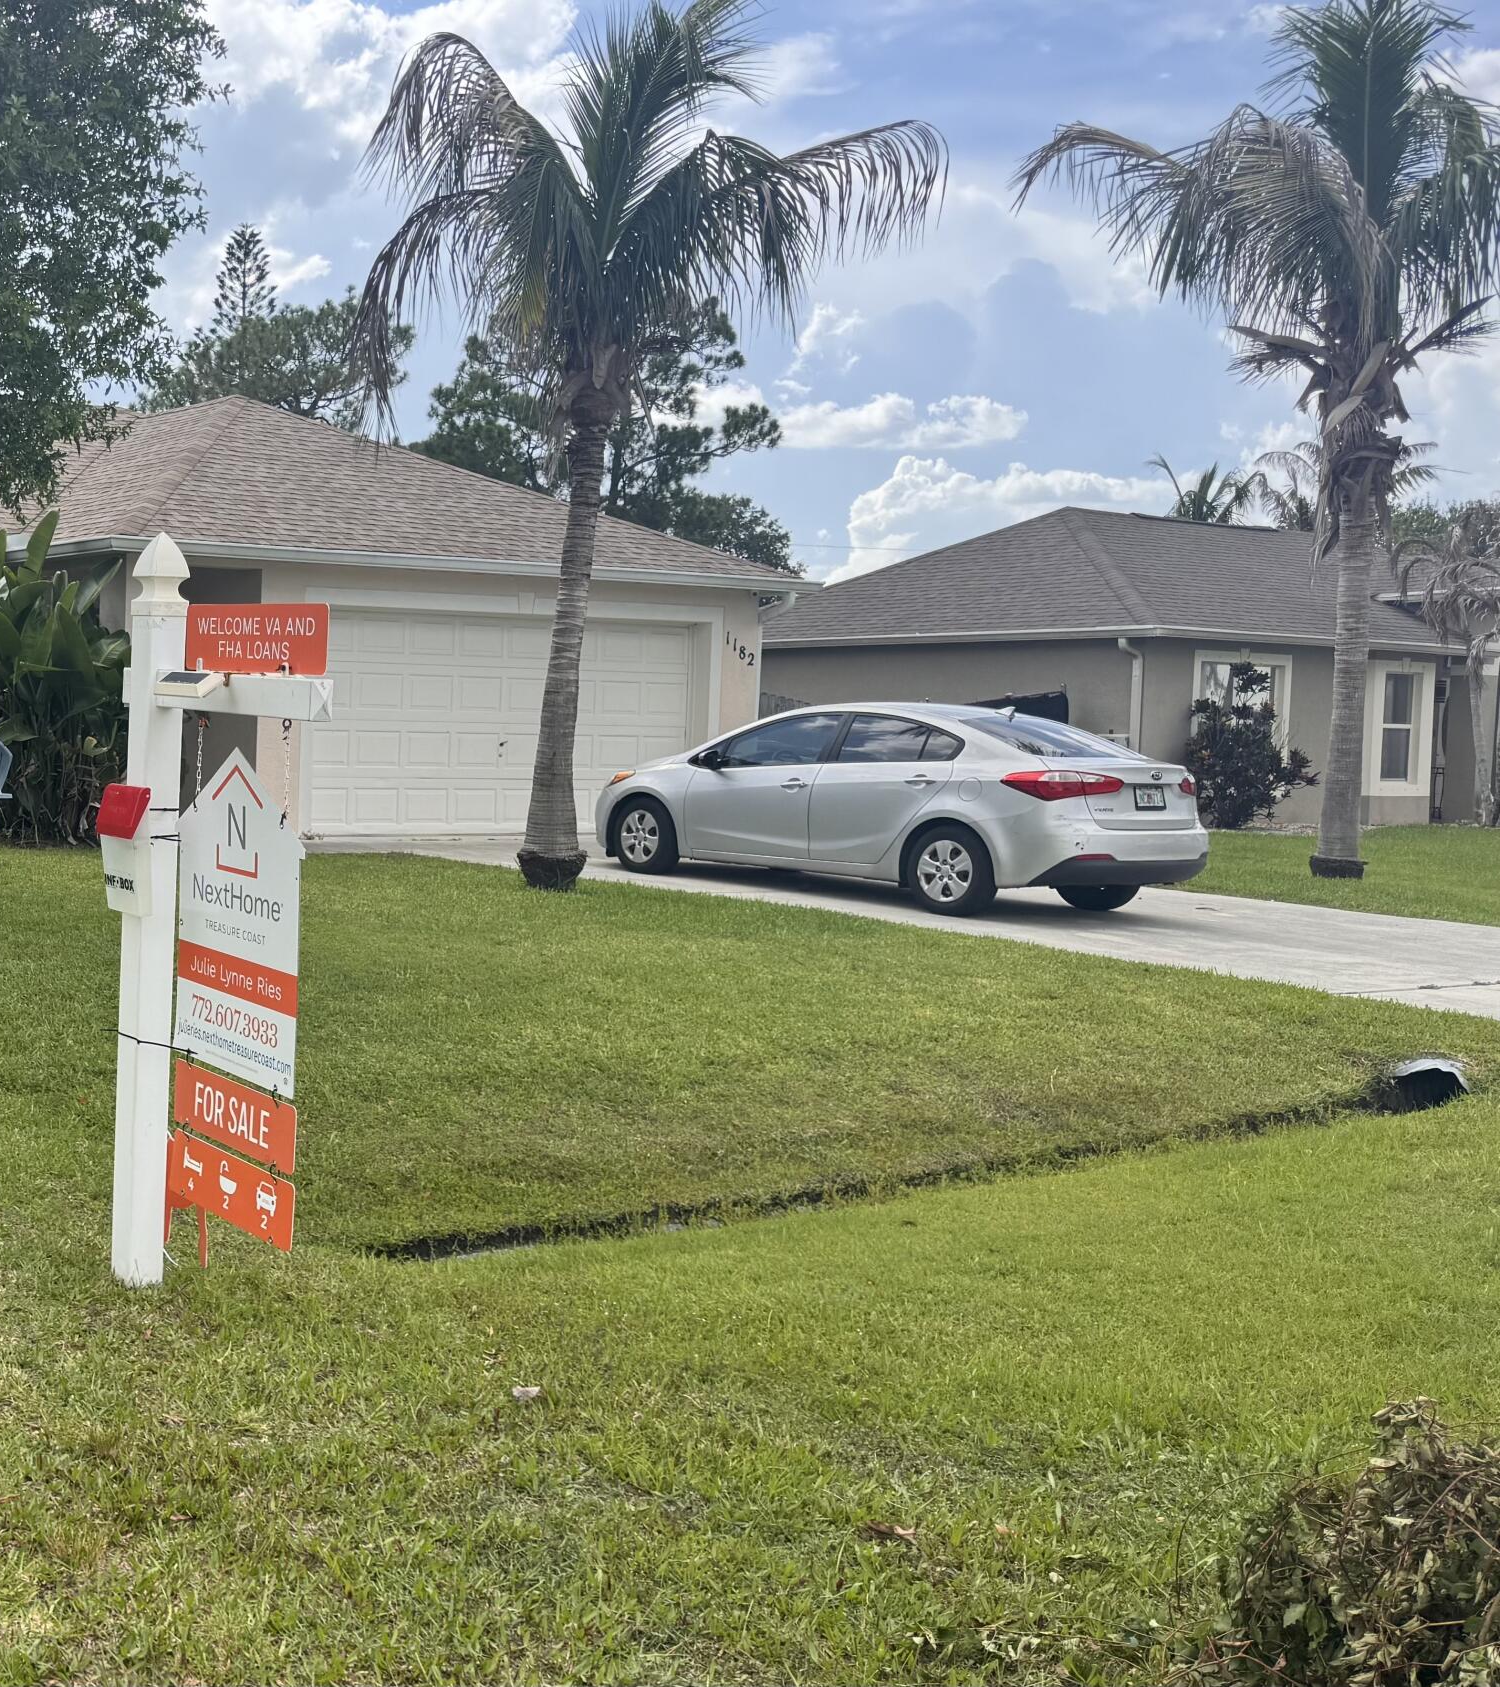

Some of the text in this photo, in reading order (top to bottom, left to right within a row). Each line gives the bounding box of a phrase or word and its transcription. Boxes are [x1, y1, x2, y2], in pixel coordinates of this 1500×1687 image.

[197, 617, 316, 636] WELCOME VA AND
[218, 640, 290, 660] FHA LOANS
[726, 631, 755, 666] 1182
[228, 802, 246, 850] N
[205, 918, 266, 946] TREASURE COAST
[190, 955, 282, 1001] Julie Lynne Ries
[191, 993, 278, 1048] 772.607.3933
[194, 1081, 270, 1150] FOR SALE
[187, 1177, 195, 1191] 4
[222, 1195, 230, 1210] 2
[260, 1214, 268, 1230] 2
